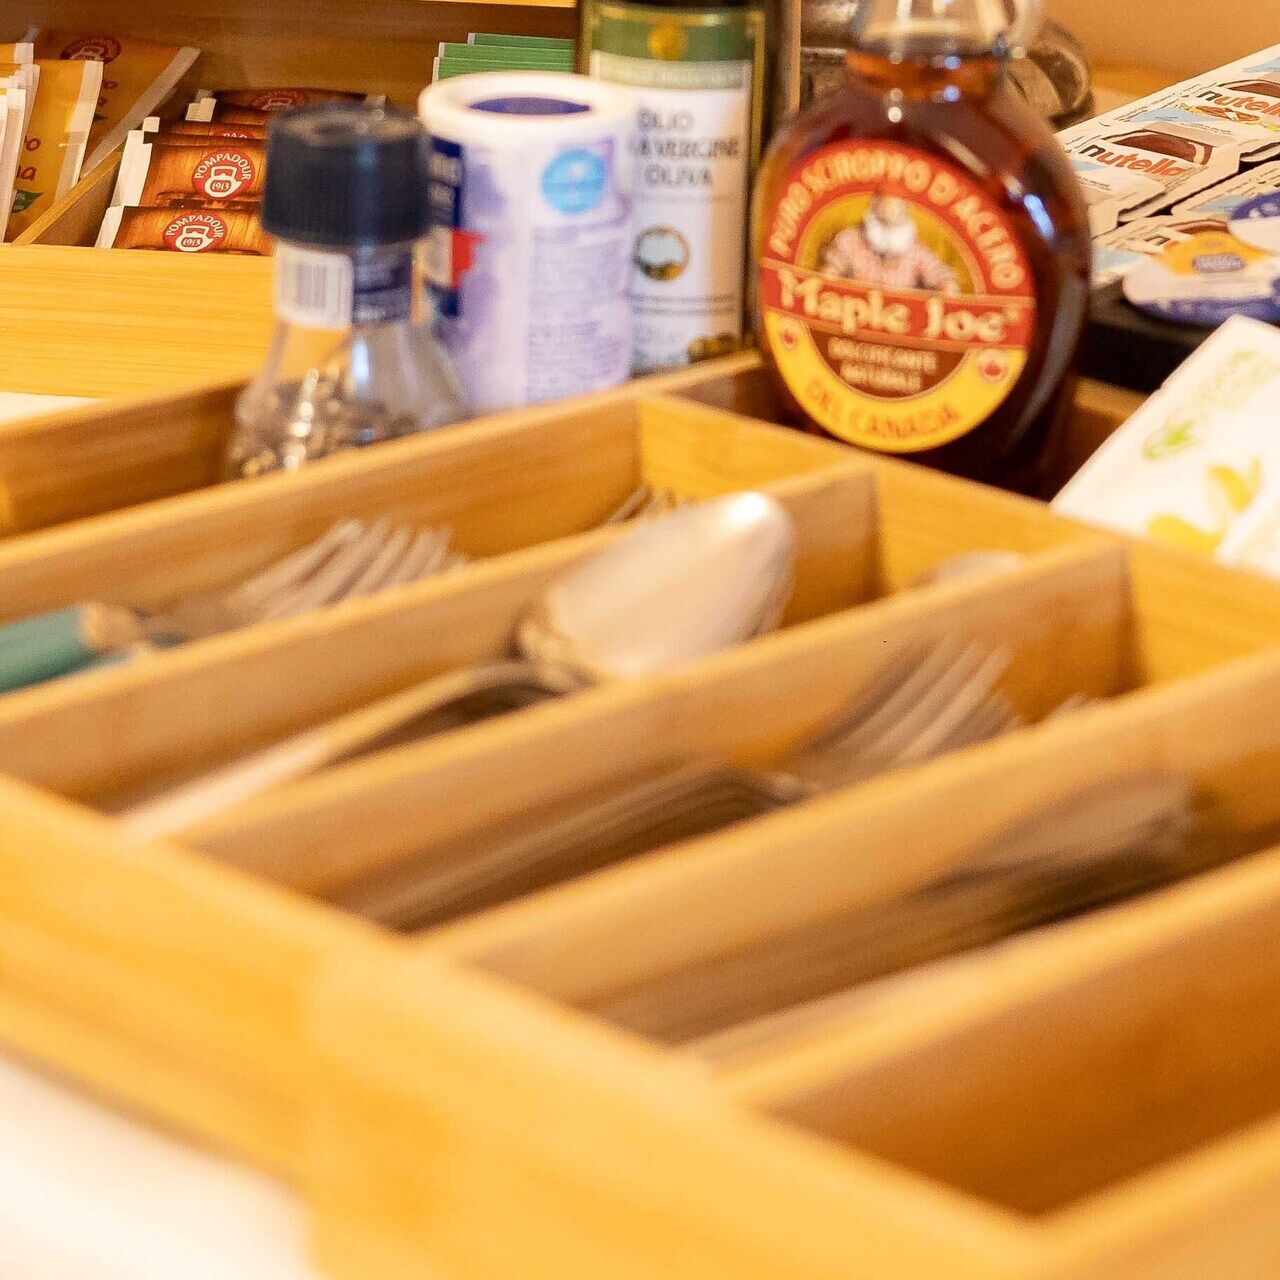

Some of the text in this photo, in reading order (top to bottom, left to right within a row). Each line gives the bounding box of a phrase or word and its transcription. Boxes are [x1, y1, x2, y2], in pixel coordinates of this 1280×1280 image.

[194, 152, 252, 181] POMPADOUR
[1079, 144, 1186, 176] nutella
[211, 179, 231, 191] 1913
[165, 214, 224, 238] POMPADOUR
[778, 269, 1006, 343] Maple Joe
